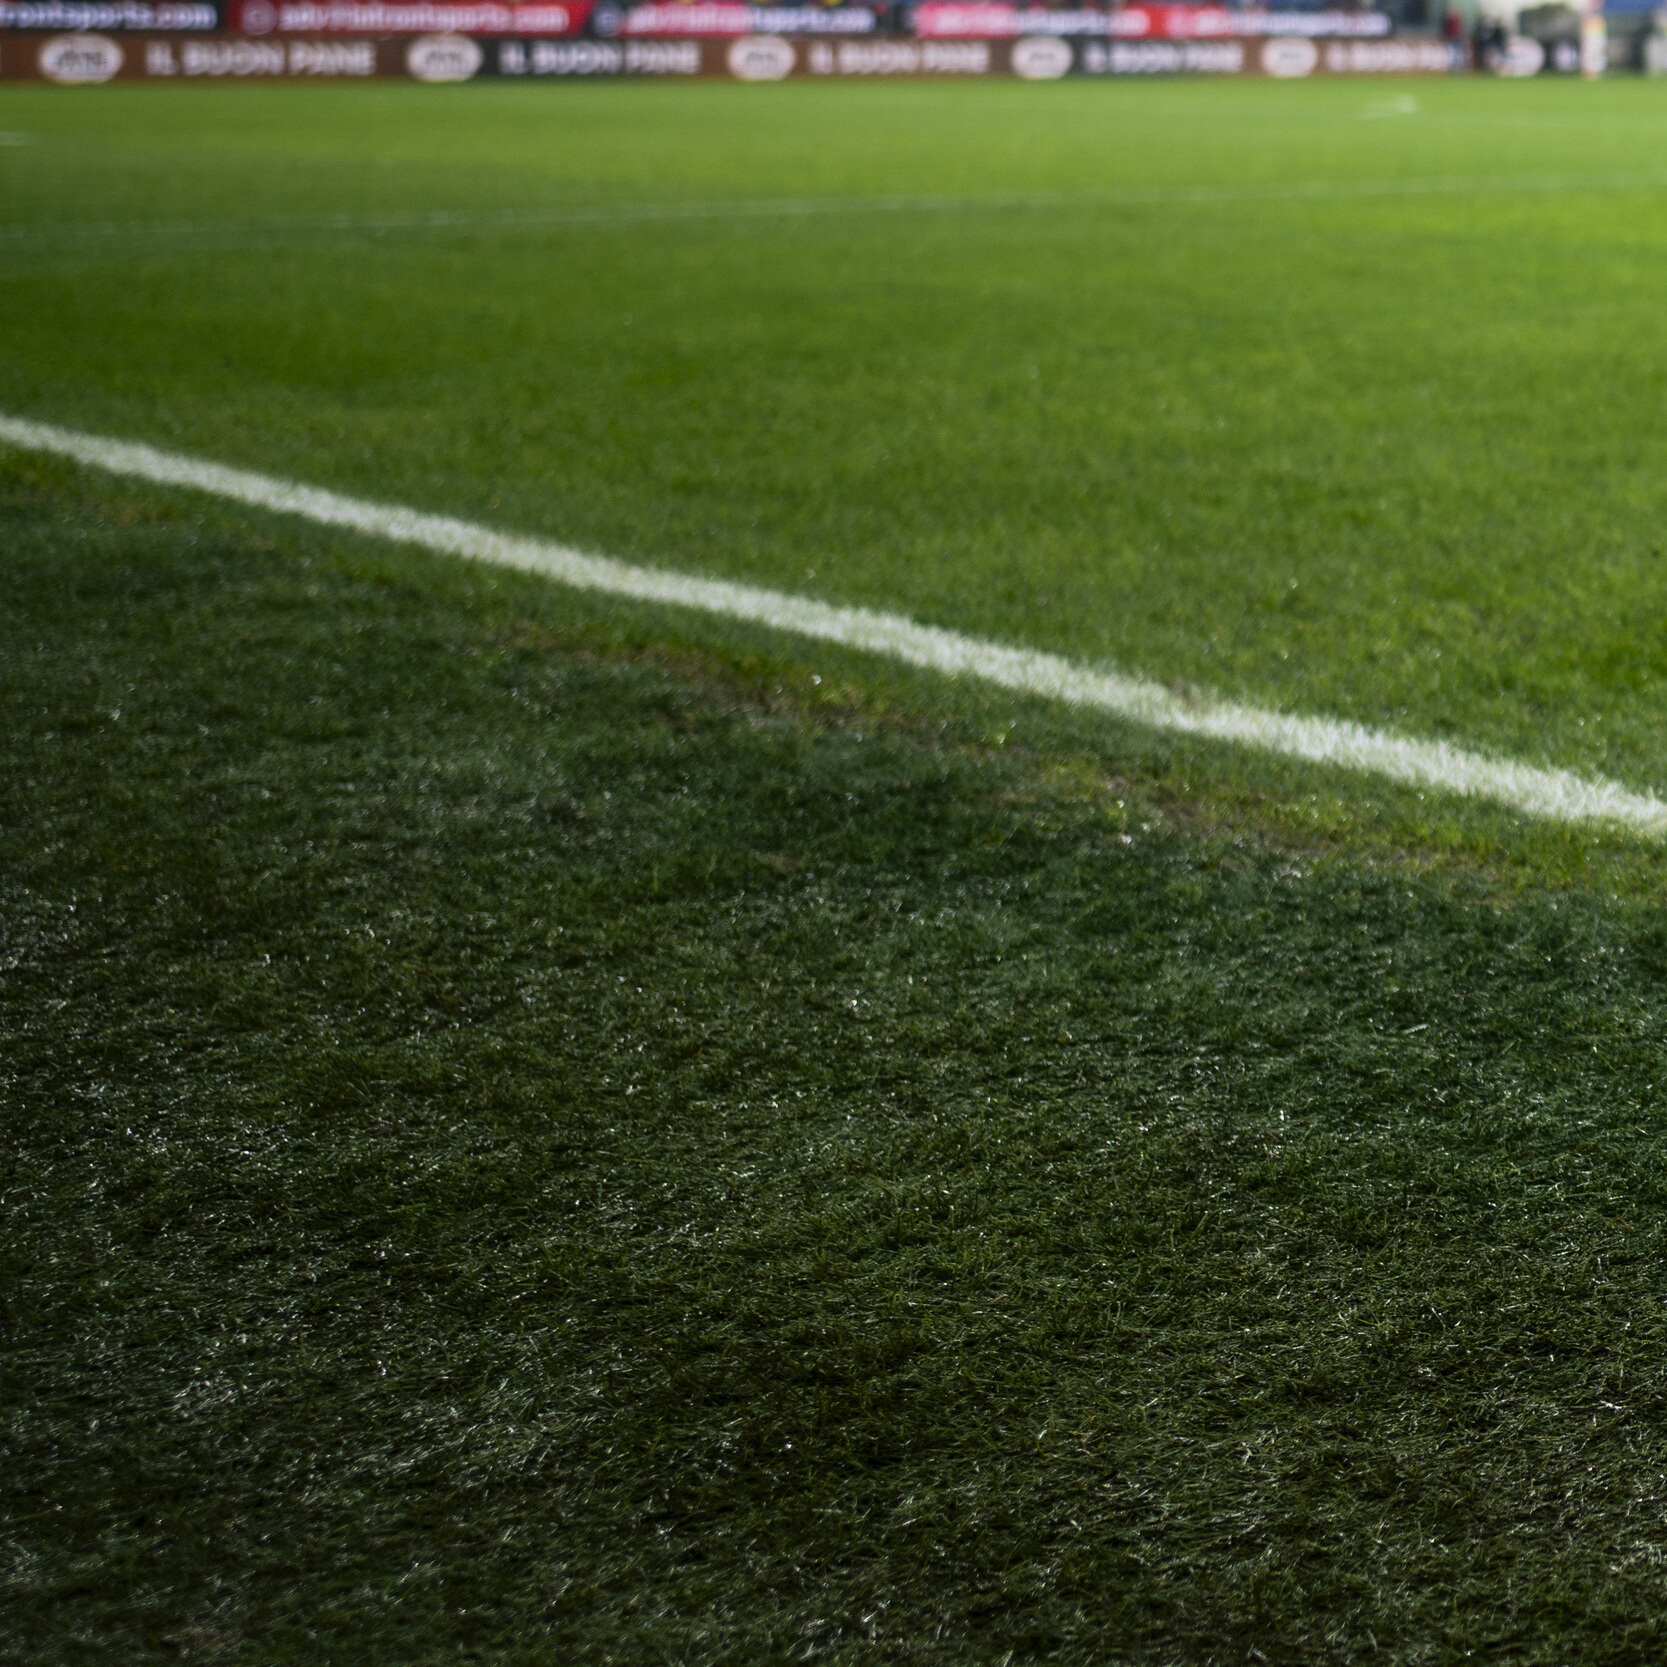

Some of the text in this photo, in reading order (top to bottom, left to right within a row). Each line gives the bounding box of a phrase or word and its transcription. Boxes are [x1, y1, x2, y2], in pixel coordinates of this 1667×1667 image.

[146, 39, 178, 76] IL
[180, 39, 285, 76] BUON
[288, 39, 377, 76] PANE
